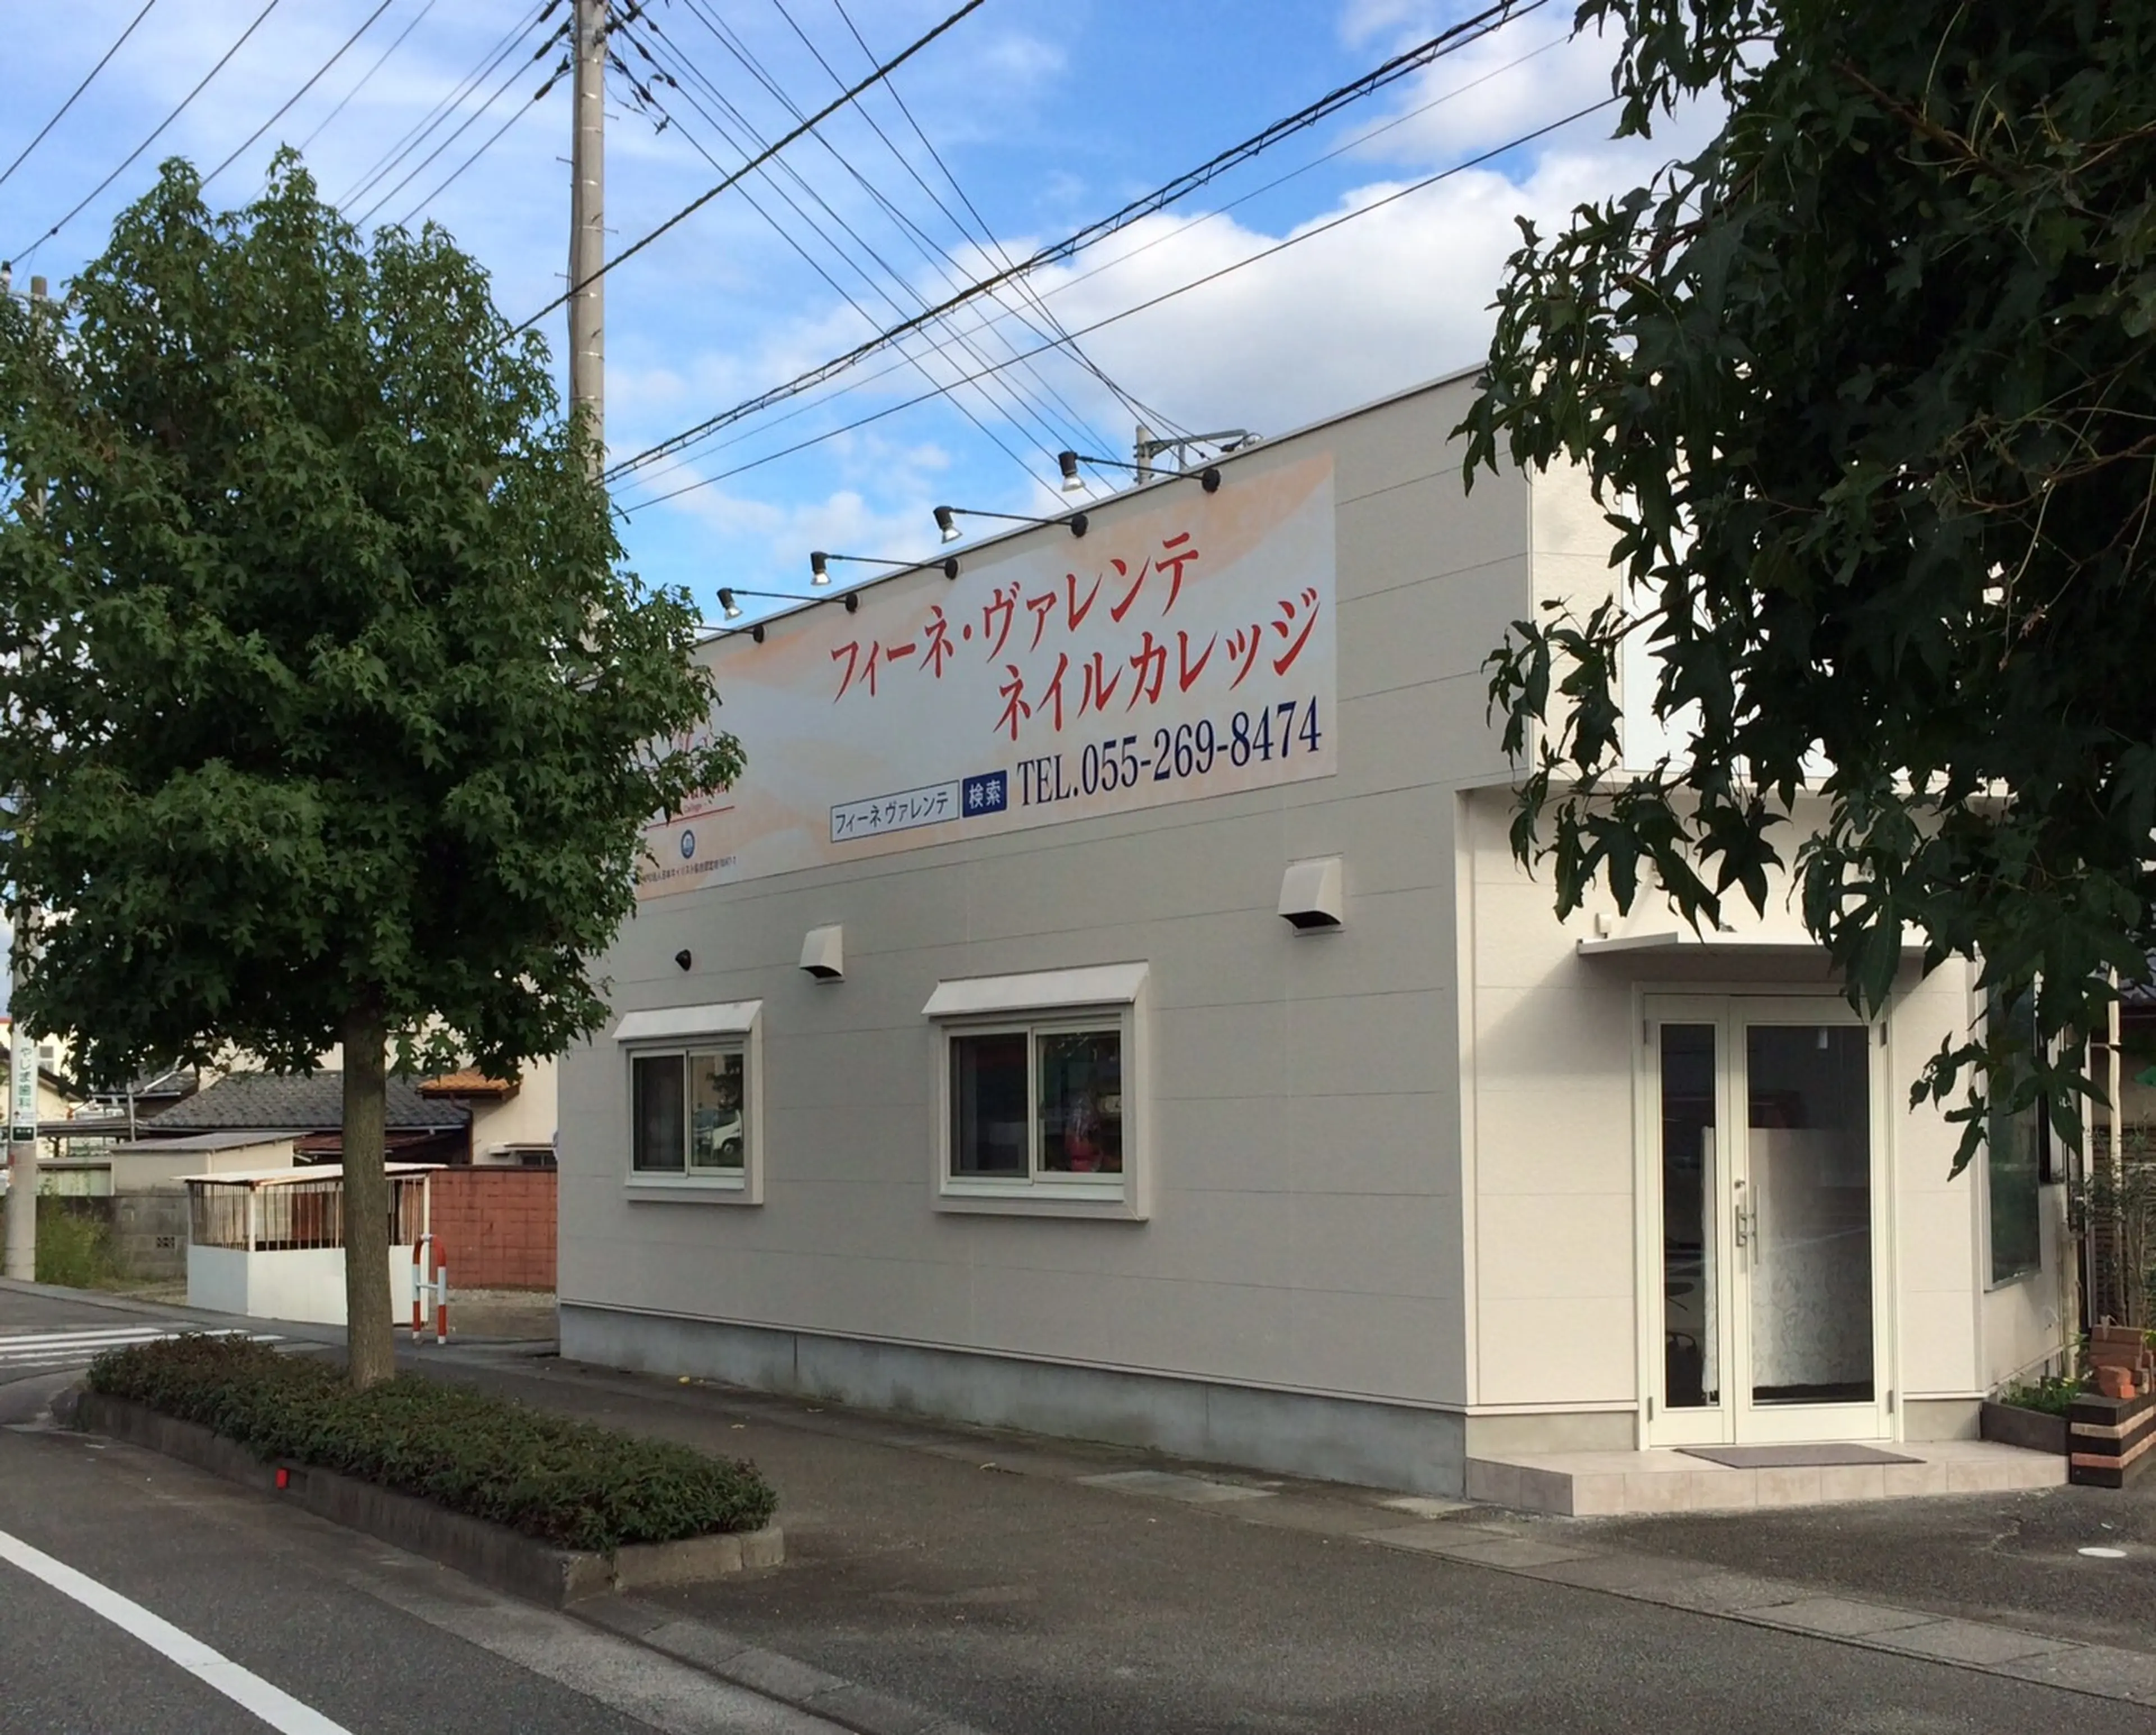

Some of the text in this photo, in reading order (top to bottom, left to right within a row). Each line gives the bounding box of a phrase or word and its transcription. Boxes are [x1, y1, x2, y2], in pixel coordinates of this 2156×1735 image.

[831, 532, 1199, 703] フィーネ・ヴァレンテ
[993, 587, 1321, 740] ネイルカレッジ
[968, 779, 1001, 809] 検索
[1017, 695, 1322, 807] TEL.055-269-8474
